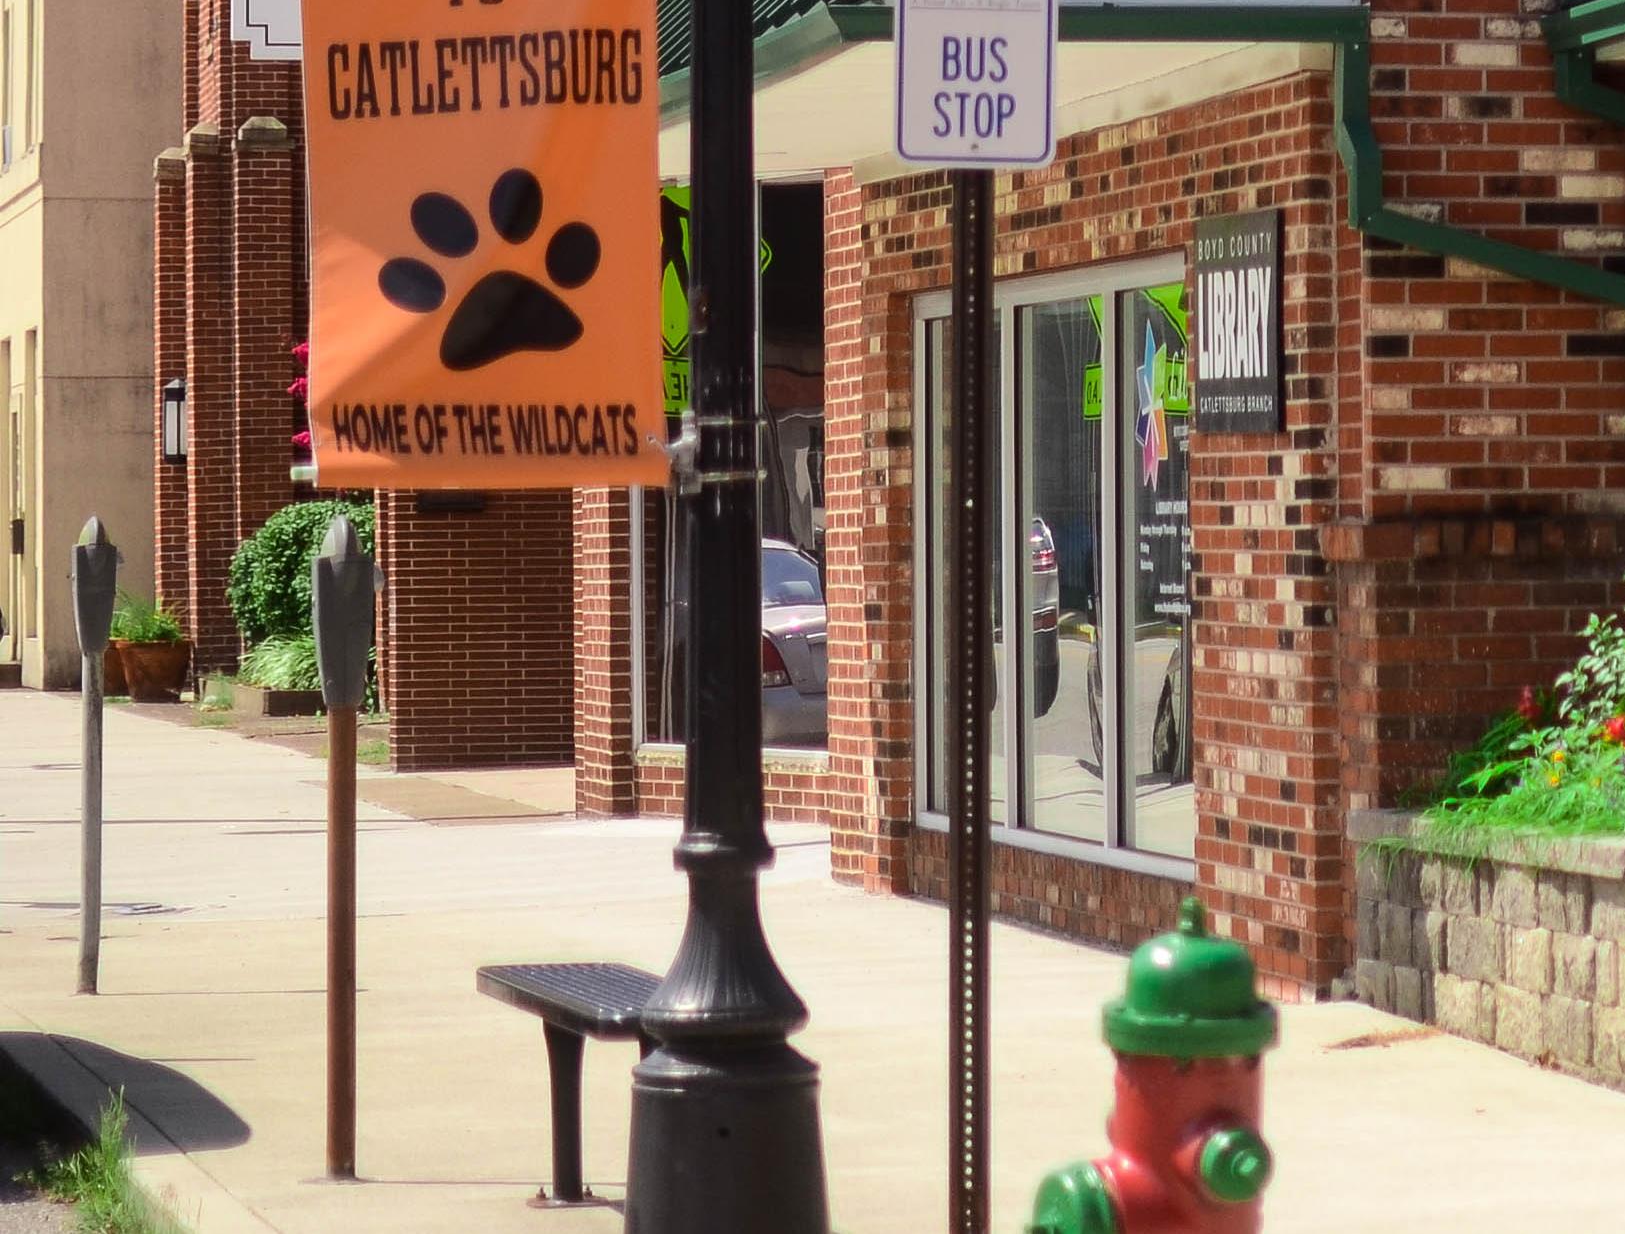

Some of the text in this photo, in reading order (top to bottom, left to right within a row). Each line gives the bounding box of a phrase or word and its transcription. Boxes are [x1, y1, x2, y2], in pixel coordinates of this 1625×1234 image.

[327, 27, 642, 120] CATLETTSBURG
[942, 36, 1009, 82] BUS
[933, 92, 1016, 138] STOP
[1198, 232, 1272, 261] BOYD COUNTY
[1198, 267, 1271, 379] LIBRARY
[1200, 394, 1273, 415] CATLETTSBURG BRANCH
[332, 404, 639, 456] HOME OF THE WILDCATS
